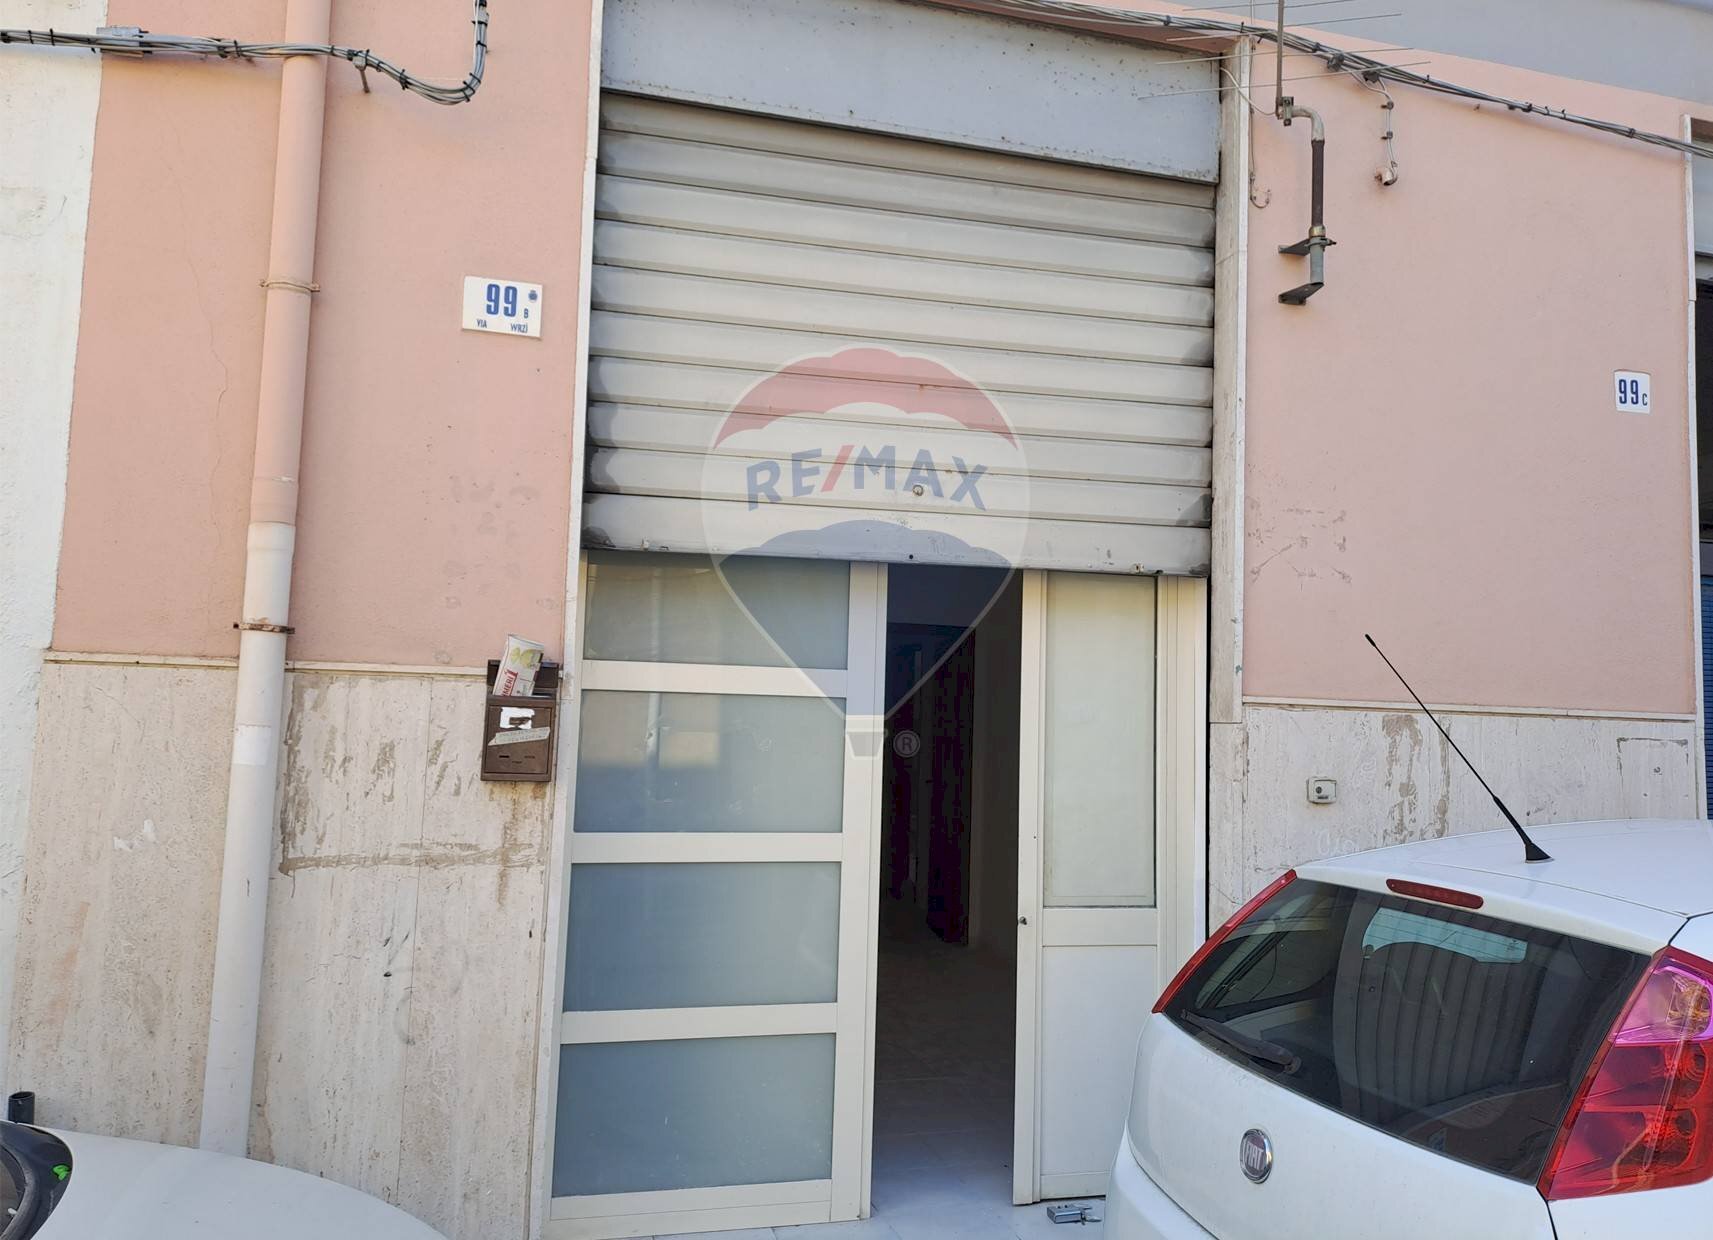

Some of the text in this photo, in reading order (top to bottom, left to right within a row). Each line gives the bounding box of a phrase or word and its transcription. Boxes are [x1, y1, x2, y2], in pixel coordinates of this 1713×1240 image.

[486, 283, 517, 317] 99
[476, 319, 487, 328] VIA
[1618, 378, 1639, 405] 99
[1245, 1141, 1264, 1170] FIAT
